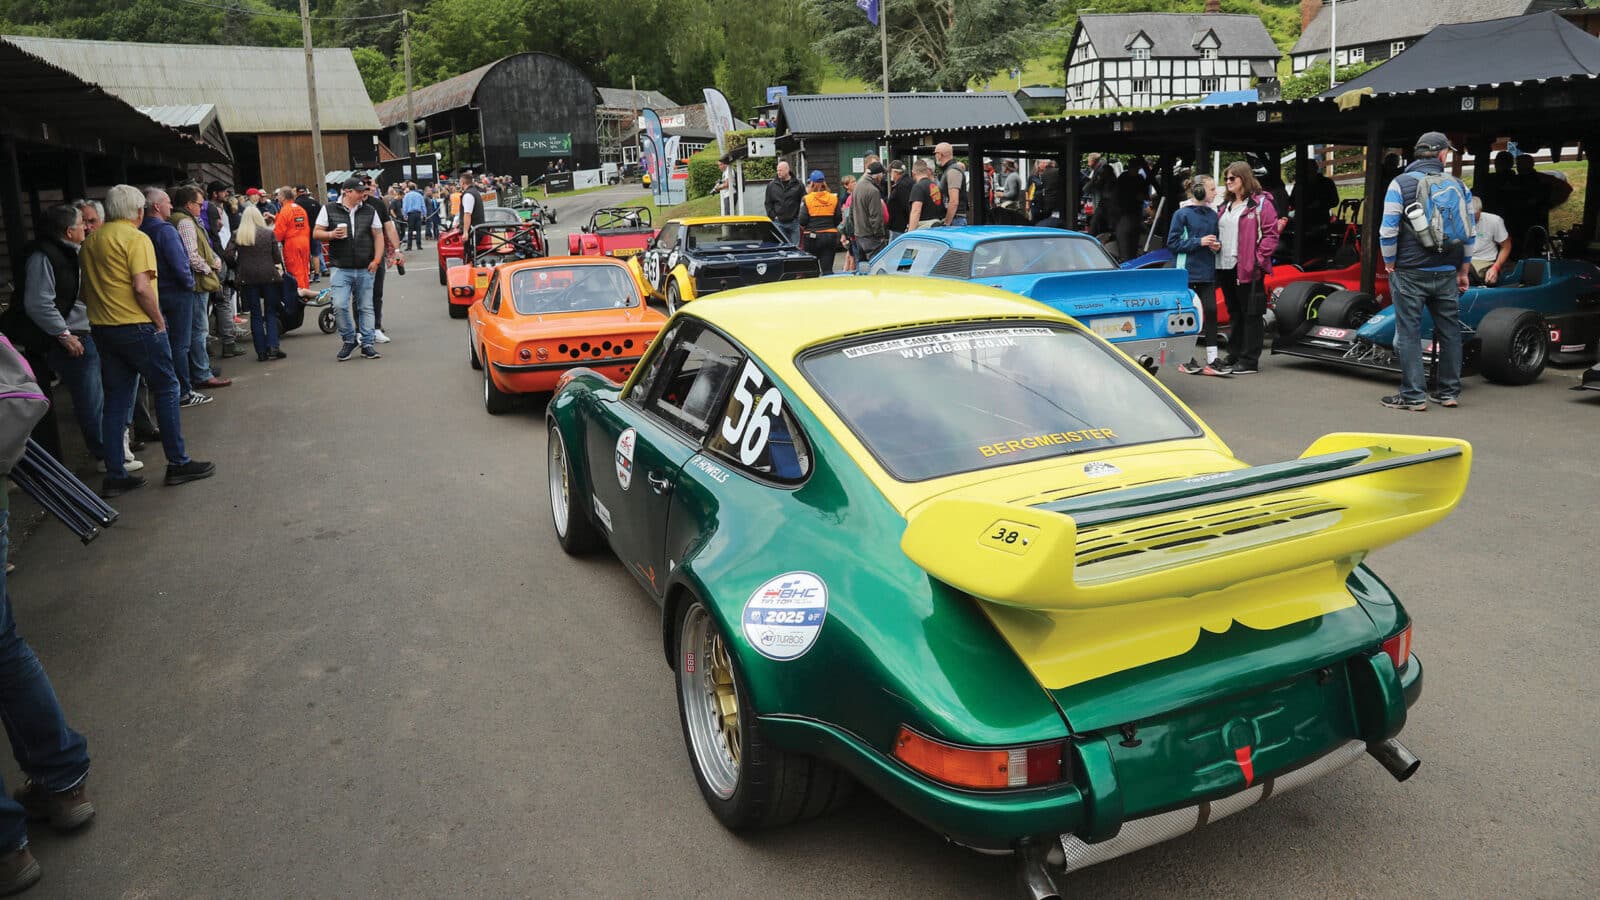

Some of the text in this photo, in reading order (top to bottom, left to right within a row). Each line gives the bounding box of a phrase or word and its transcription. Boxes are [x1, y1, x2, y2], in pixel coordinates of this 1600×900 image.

[522, 141, 546, 149] ELMS
[1318, 328, 1346, 338] SBD
[847, 340, 900, 357] WYEDEAN
[901, 335, 940, 347] CANOE
[942, 334, 950, 342] &
[899, 337, 1018, 359] wyedean.co.uk
[722, 358, 782, 466] 56
[978, 427, 1119, 458] BERGMEISTER
[991, 527, 1019, 544] 3.8
[765, 610, 806, 624] 2025
[776, 635, 804, 644] TURBOS
